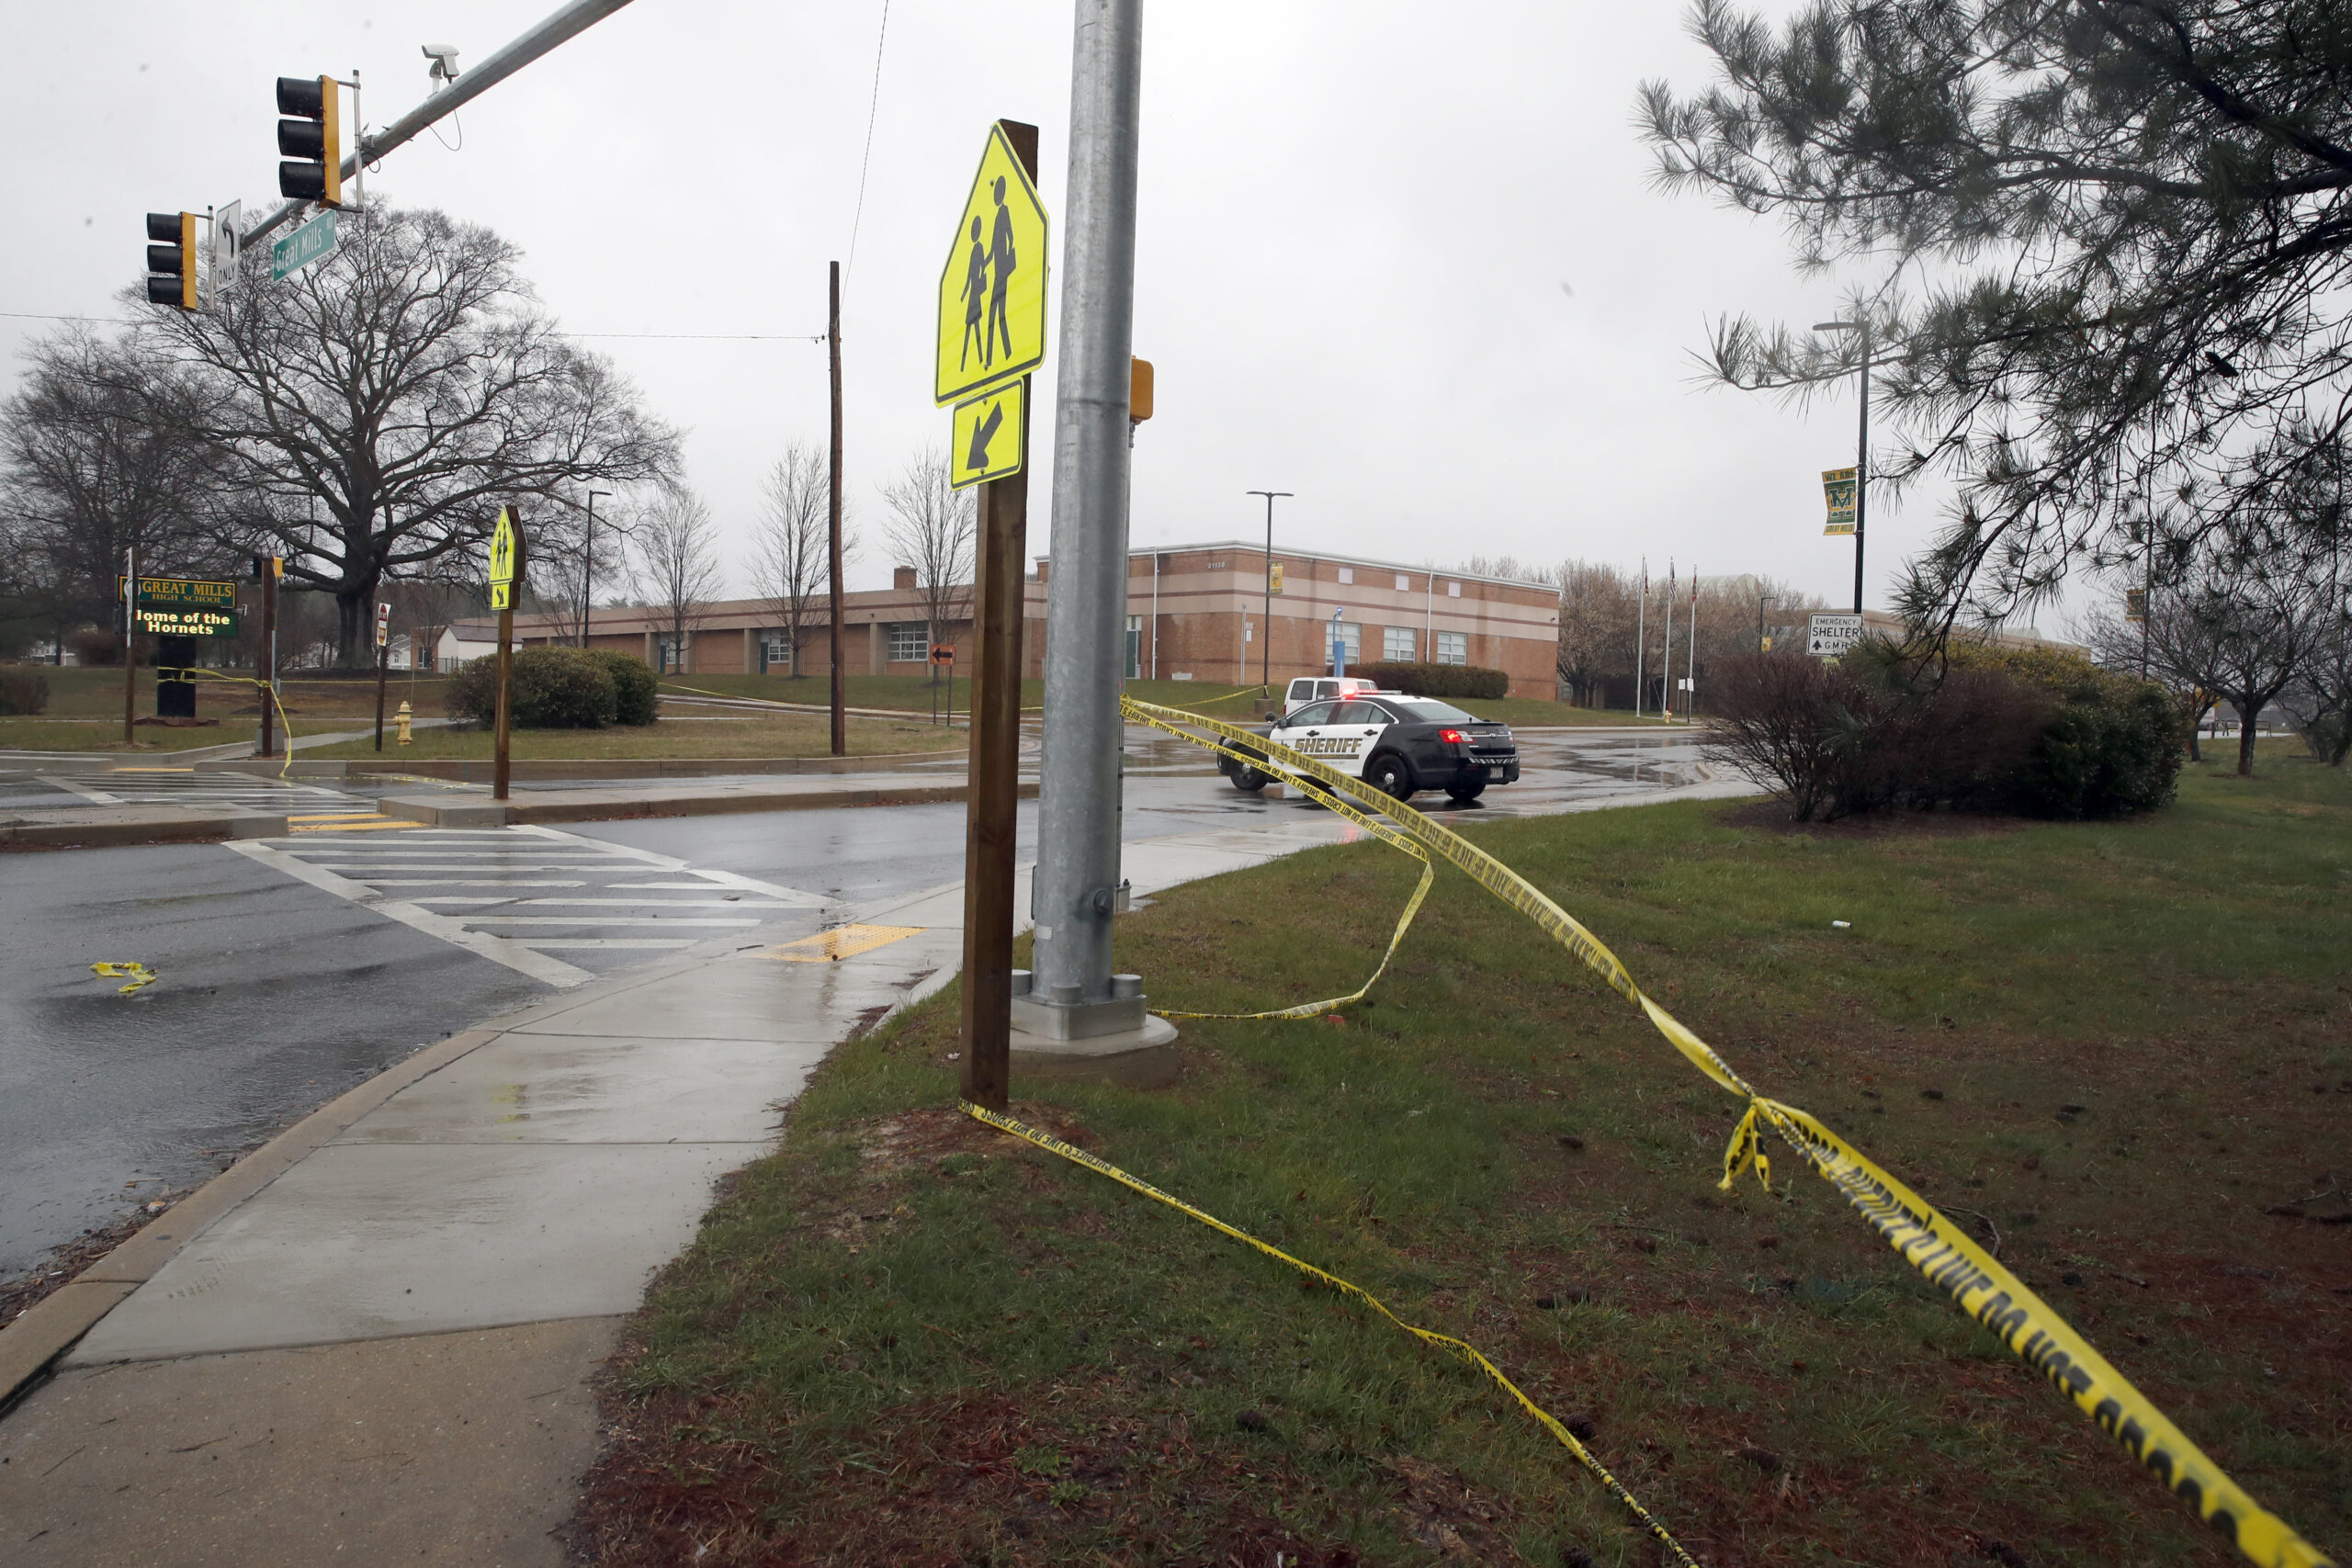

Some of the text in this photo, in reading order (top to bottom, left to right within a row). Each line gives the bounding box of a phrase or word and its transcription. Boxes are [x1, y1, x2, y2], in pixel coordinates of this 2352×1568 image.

[277, 239, 298, 272] Great
[301, 225, 322, 257] Mills
[218, 264, 236, 284] ONLY
[1825, 472, 1837, 481] WE
[141, 581, 232, 597] GREAT MILLS
[153, 593, 222, 604] HIGH SCHOOL
[183, 613, 200, 624] of
[203, 614, 231, 625] the
[147, 621, 214, 635] Hornets
[1812, 626, 1860, 637] SHELTER
[1295, 738, 1363, 753] SHERIFF
[1321, 795, 1342, 812] CROSS
